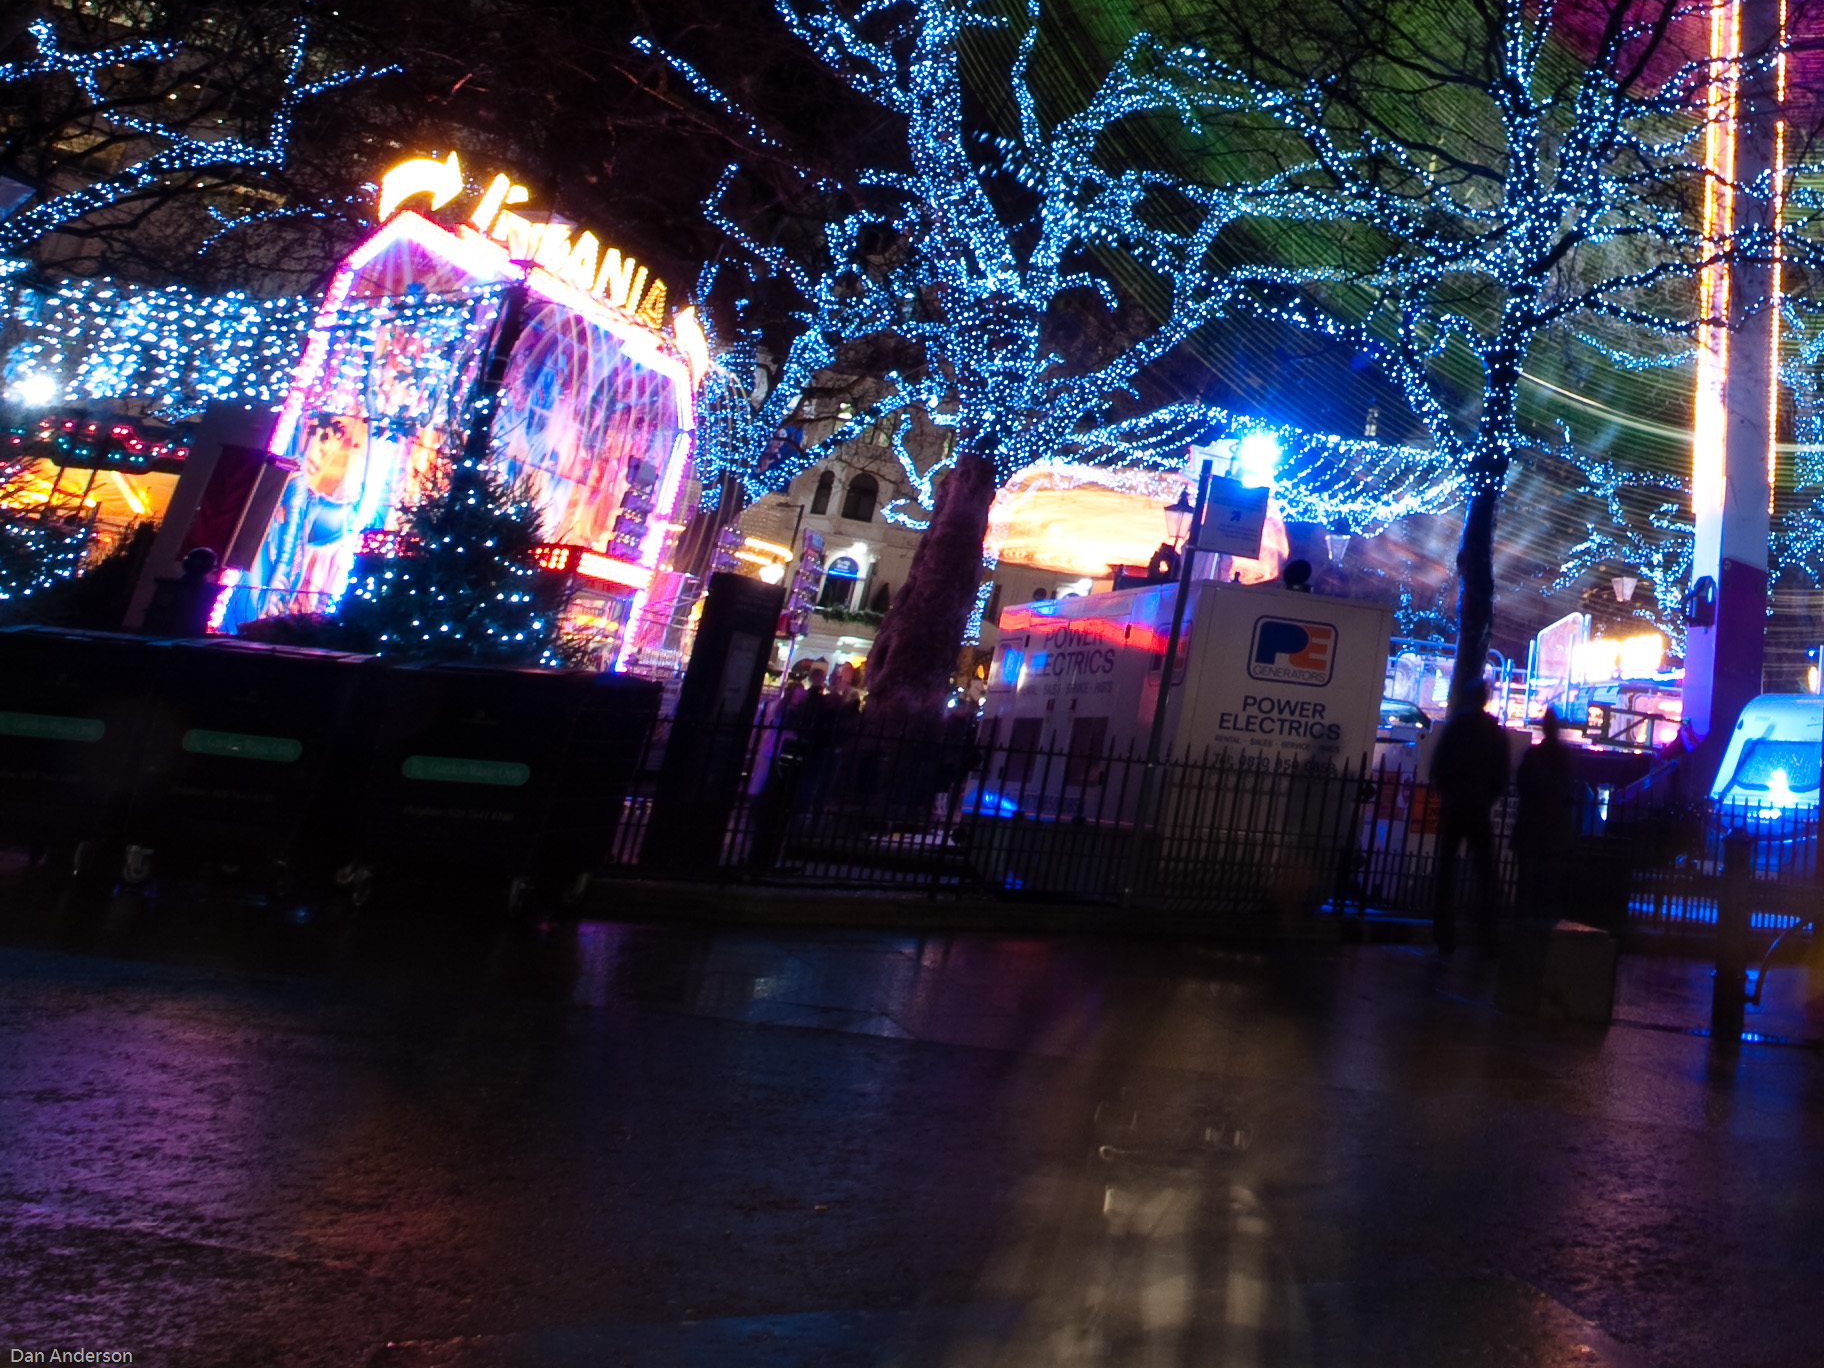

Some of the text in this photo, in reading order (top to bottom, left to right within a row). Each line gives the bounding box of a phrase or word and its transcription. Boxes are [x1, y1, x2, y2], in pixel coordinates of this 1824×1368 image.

[1252, 664, 1327, 683] GENERATORS
[1242, 695, 1326, 720] POWER
[1218, 712, 1341, 741] ELECTRICS
